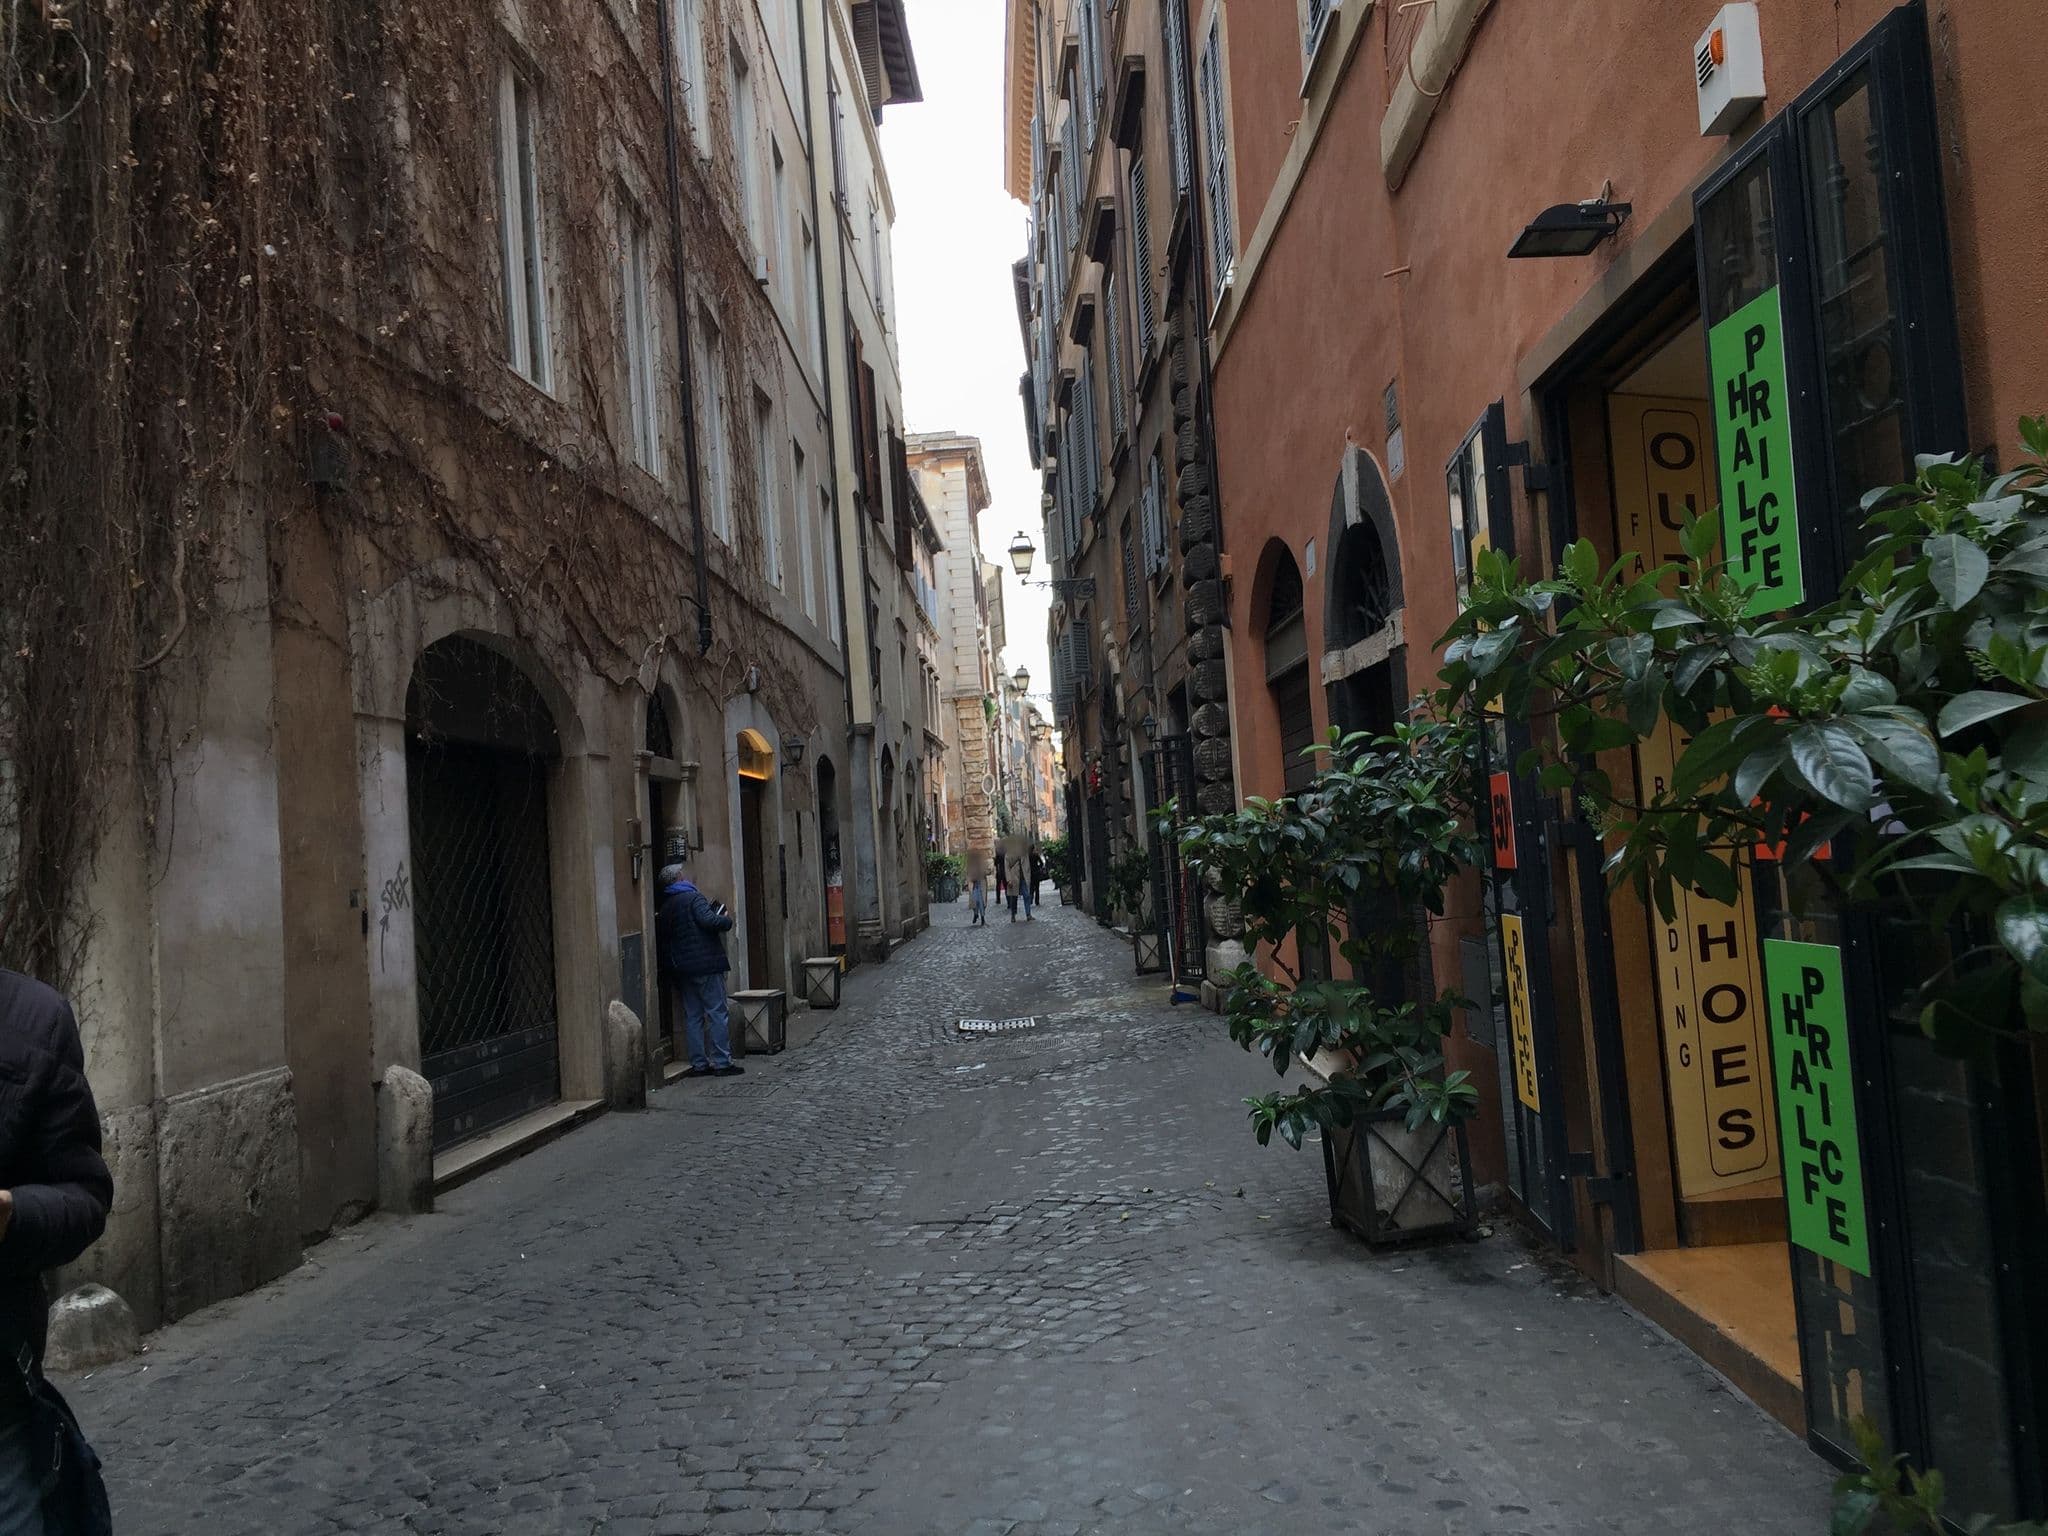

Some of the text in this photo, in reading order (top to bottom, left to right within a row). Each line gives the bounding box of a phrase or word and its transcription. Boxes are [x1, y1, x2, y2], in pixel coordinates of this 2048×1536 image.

[1726, 323, 1784, 588] HALF PRICE
[1507, 929, 1534, 1098] HALF PRICE
[1694, 886, 1757, 1152] HOES
[1781, 966, 1851, 1246] HALF PRICE
